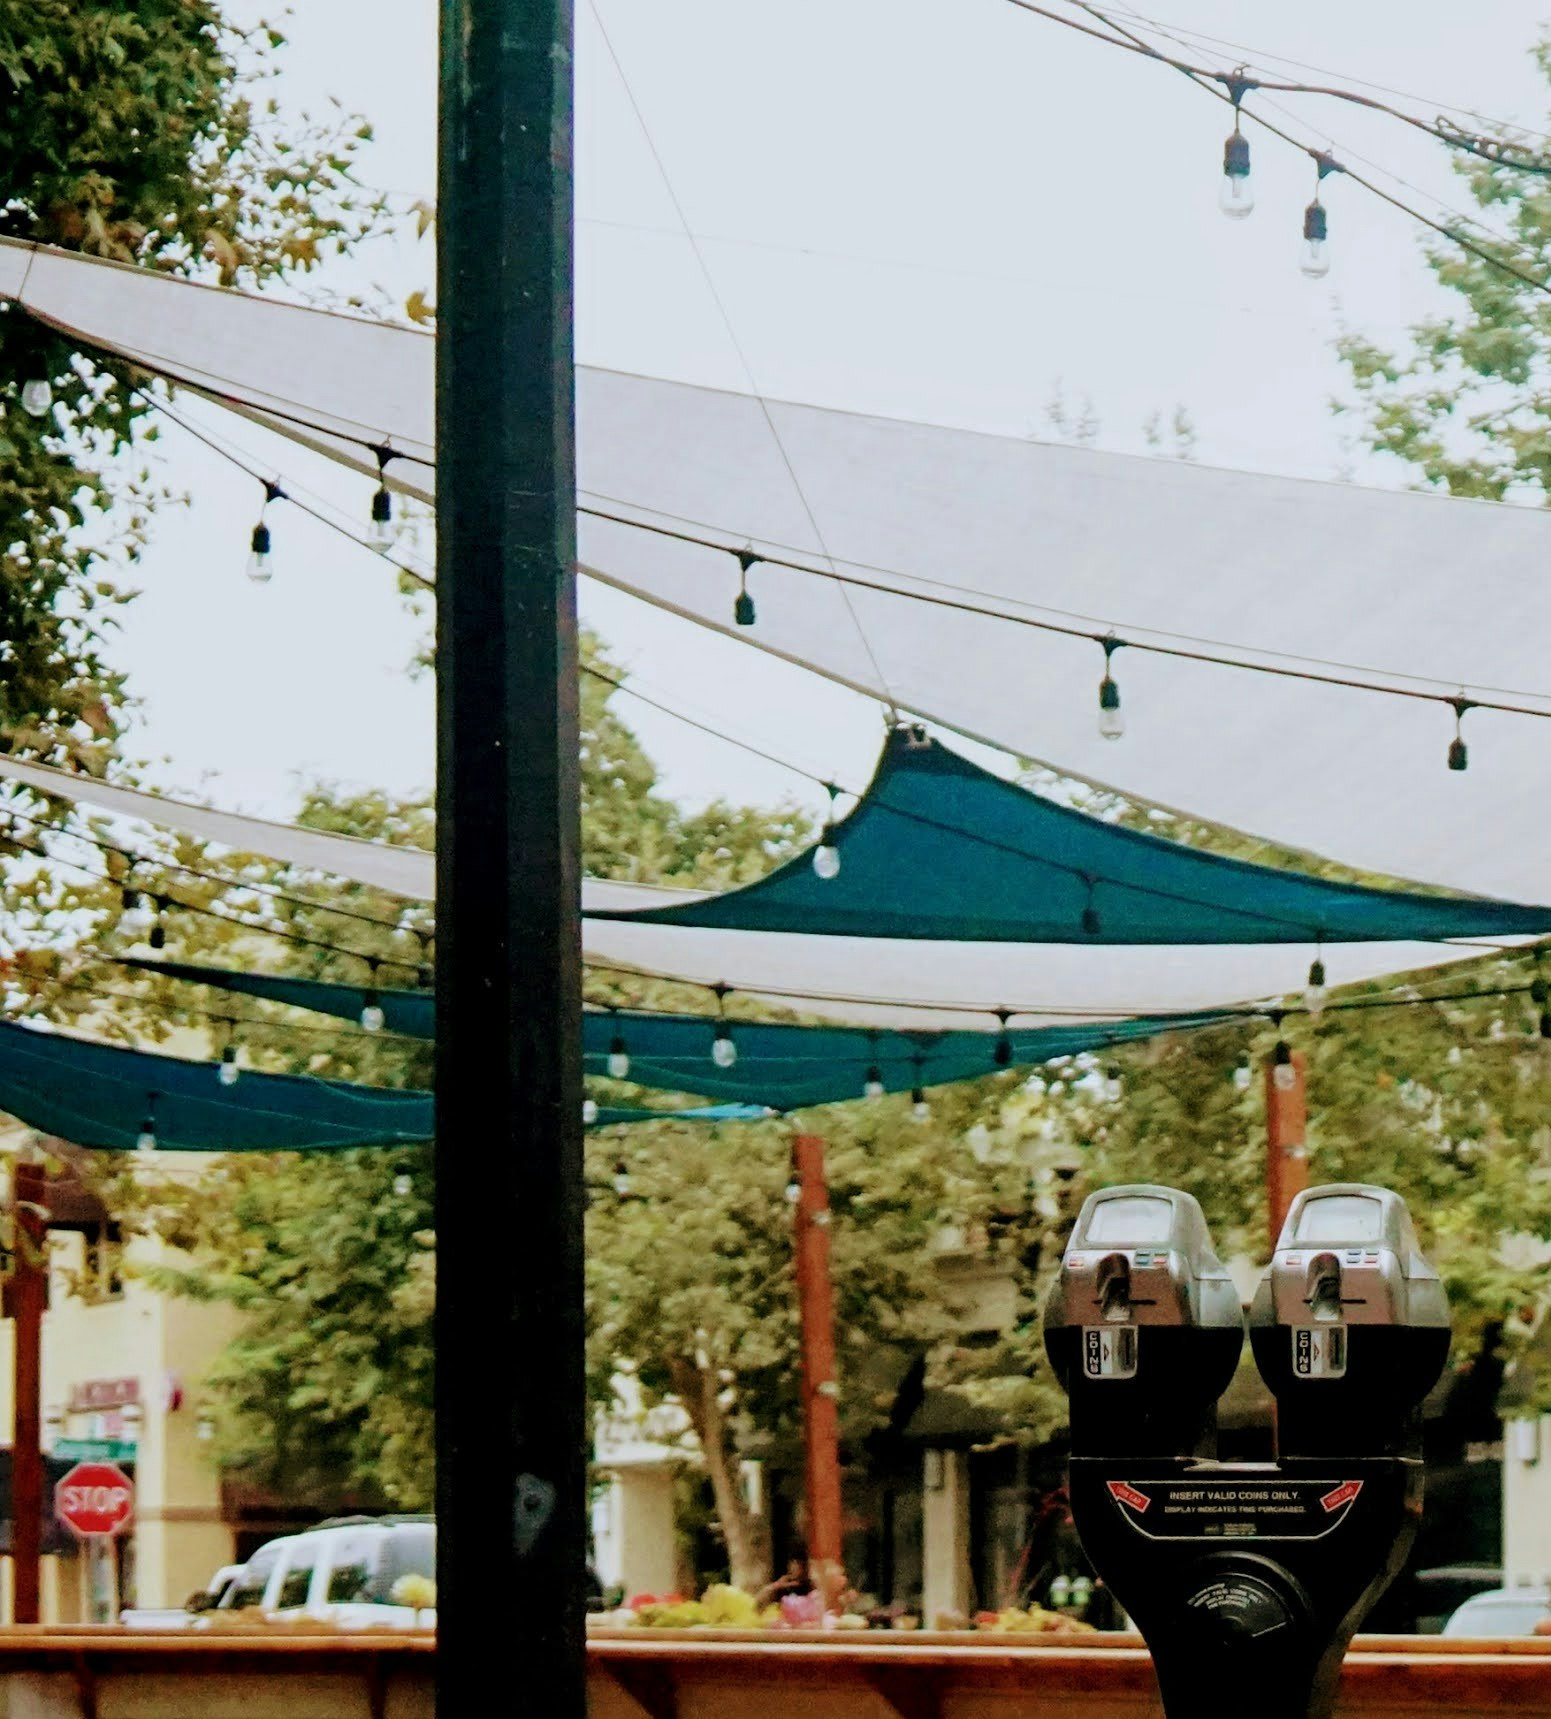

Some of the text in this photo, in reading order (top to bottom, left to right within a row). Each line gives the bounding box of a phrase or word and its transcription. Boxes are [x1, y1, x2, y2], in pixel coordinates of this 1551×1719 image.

[1089, 1331, 1099, 1373] COINS
[1299, 1331, 1309, 1373] COINS
[63, 1485, 130, 1513] STOP
[1169, 1491, 1205, 1500] INSERT
[1206, 1491, 1237, 1500] VALID
[1238, 1491, 1269, 1500] COINS
